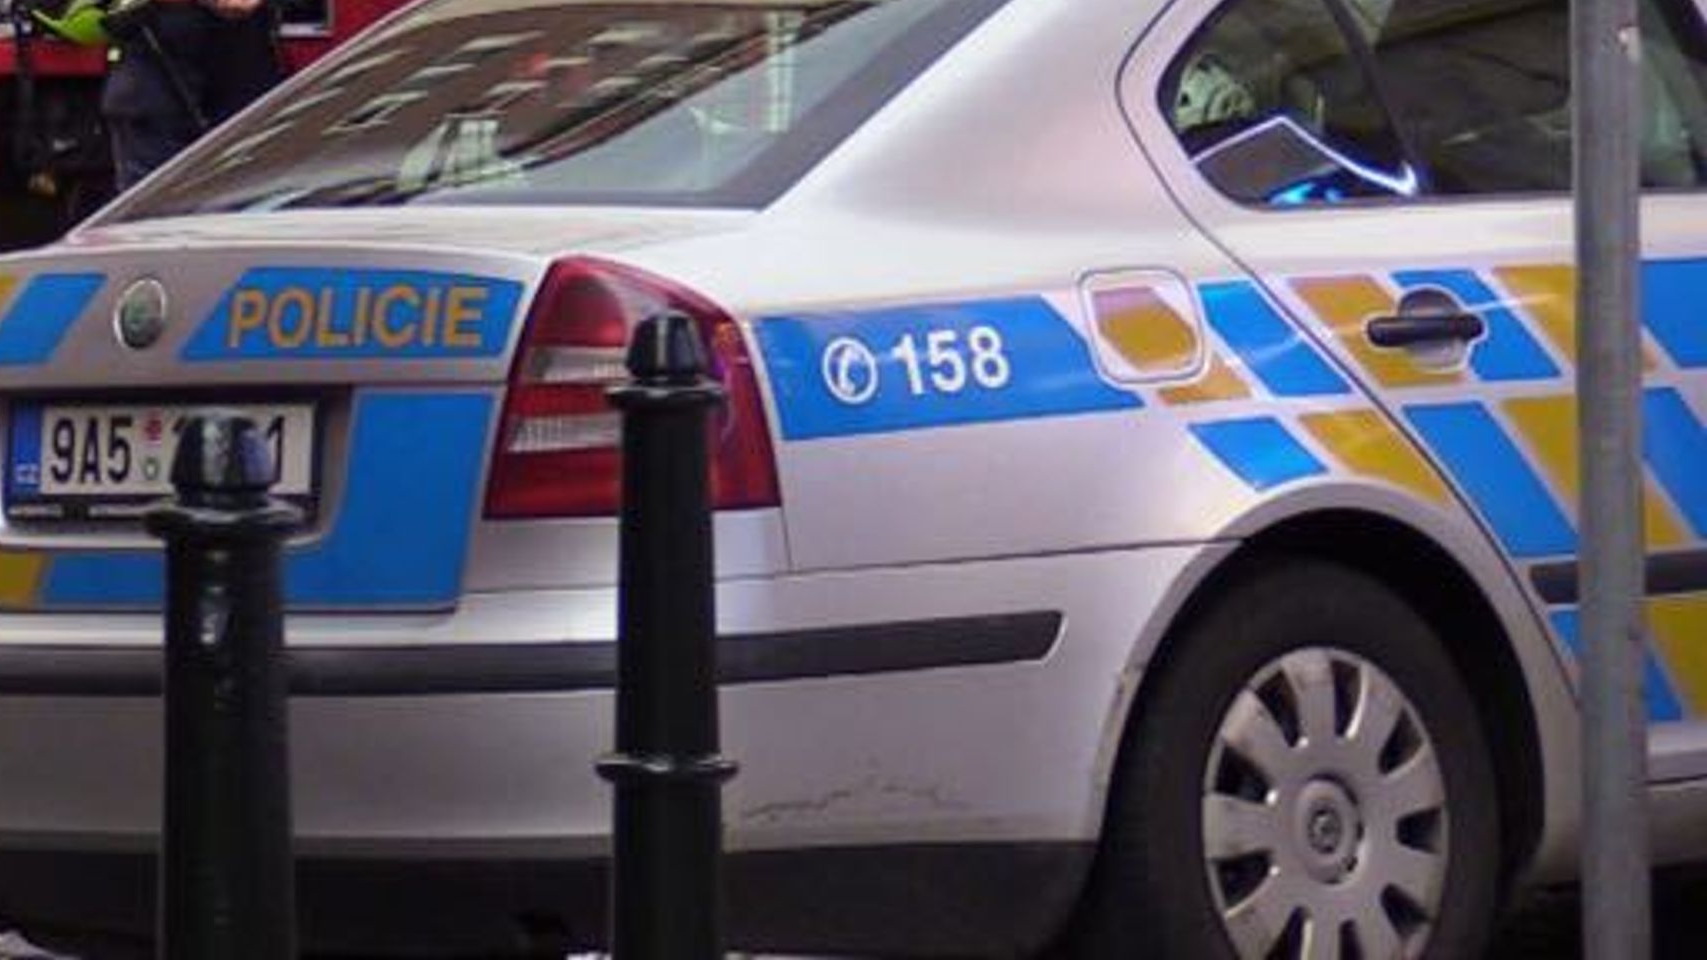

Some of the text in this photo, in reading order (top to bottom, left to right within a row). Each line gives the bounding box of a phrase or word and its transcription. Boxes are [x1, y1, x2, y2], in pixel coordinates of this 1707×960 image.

[227, 283, 489, 348] POLICIE
[892, 325, 1010, 395] 158
[50, 416, 133, 484] 9A5
